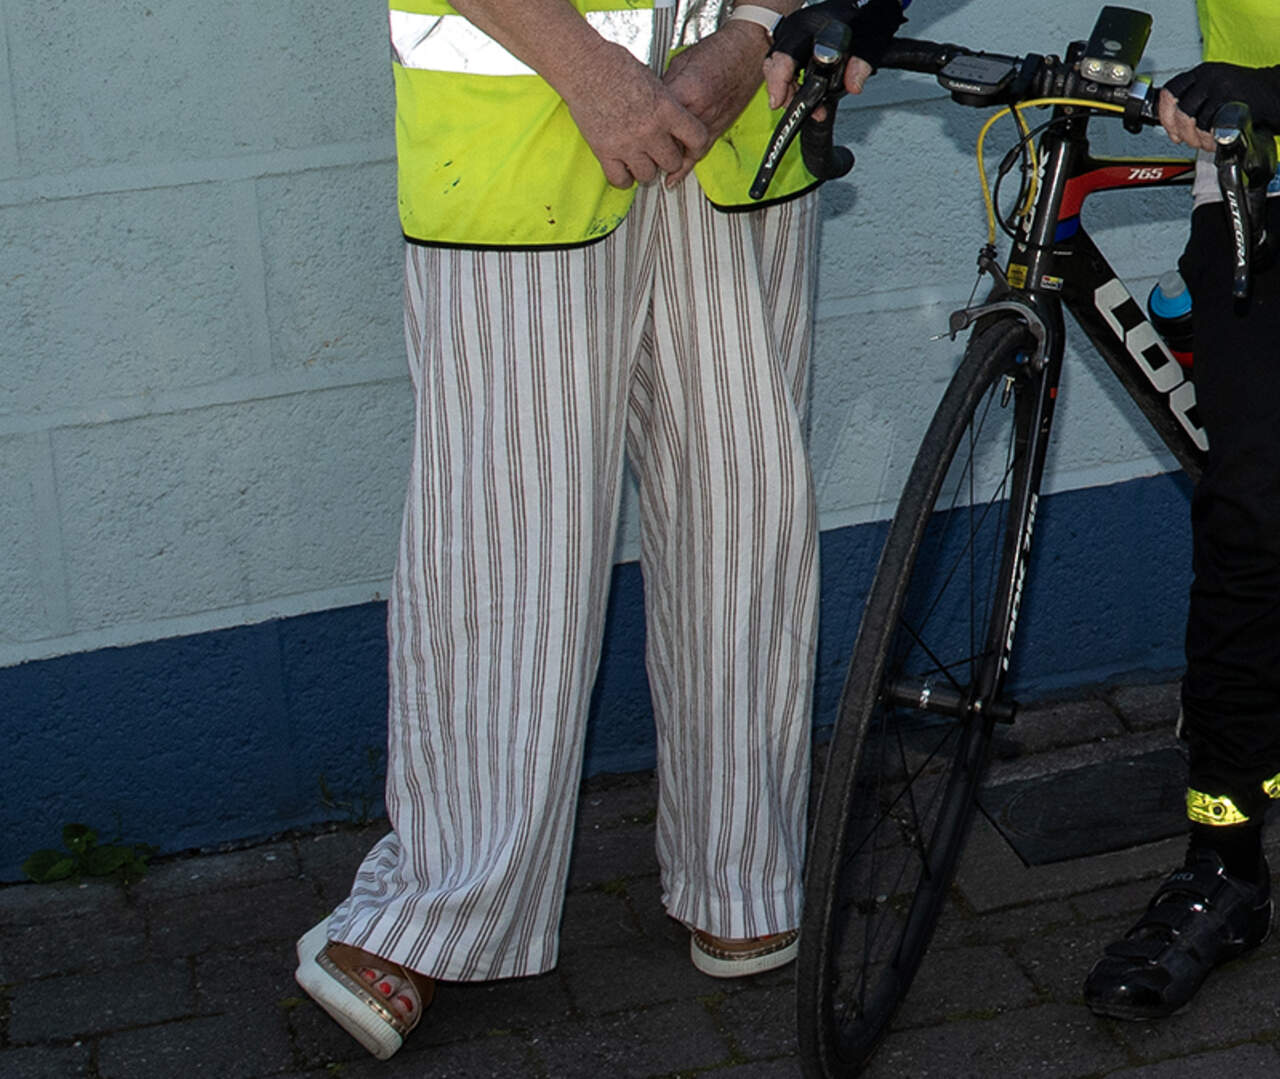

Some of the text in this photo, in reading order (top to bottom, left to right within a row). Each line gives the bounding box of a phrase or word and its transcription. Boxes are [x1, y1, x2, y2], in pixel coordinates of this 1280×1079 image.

[765, 102, 805, 168] ULTEGRA
[1128, 168, 1164, 180] 765
[1227, 190, 1248, 267] ULTEGRA
